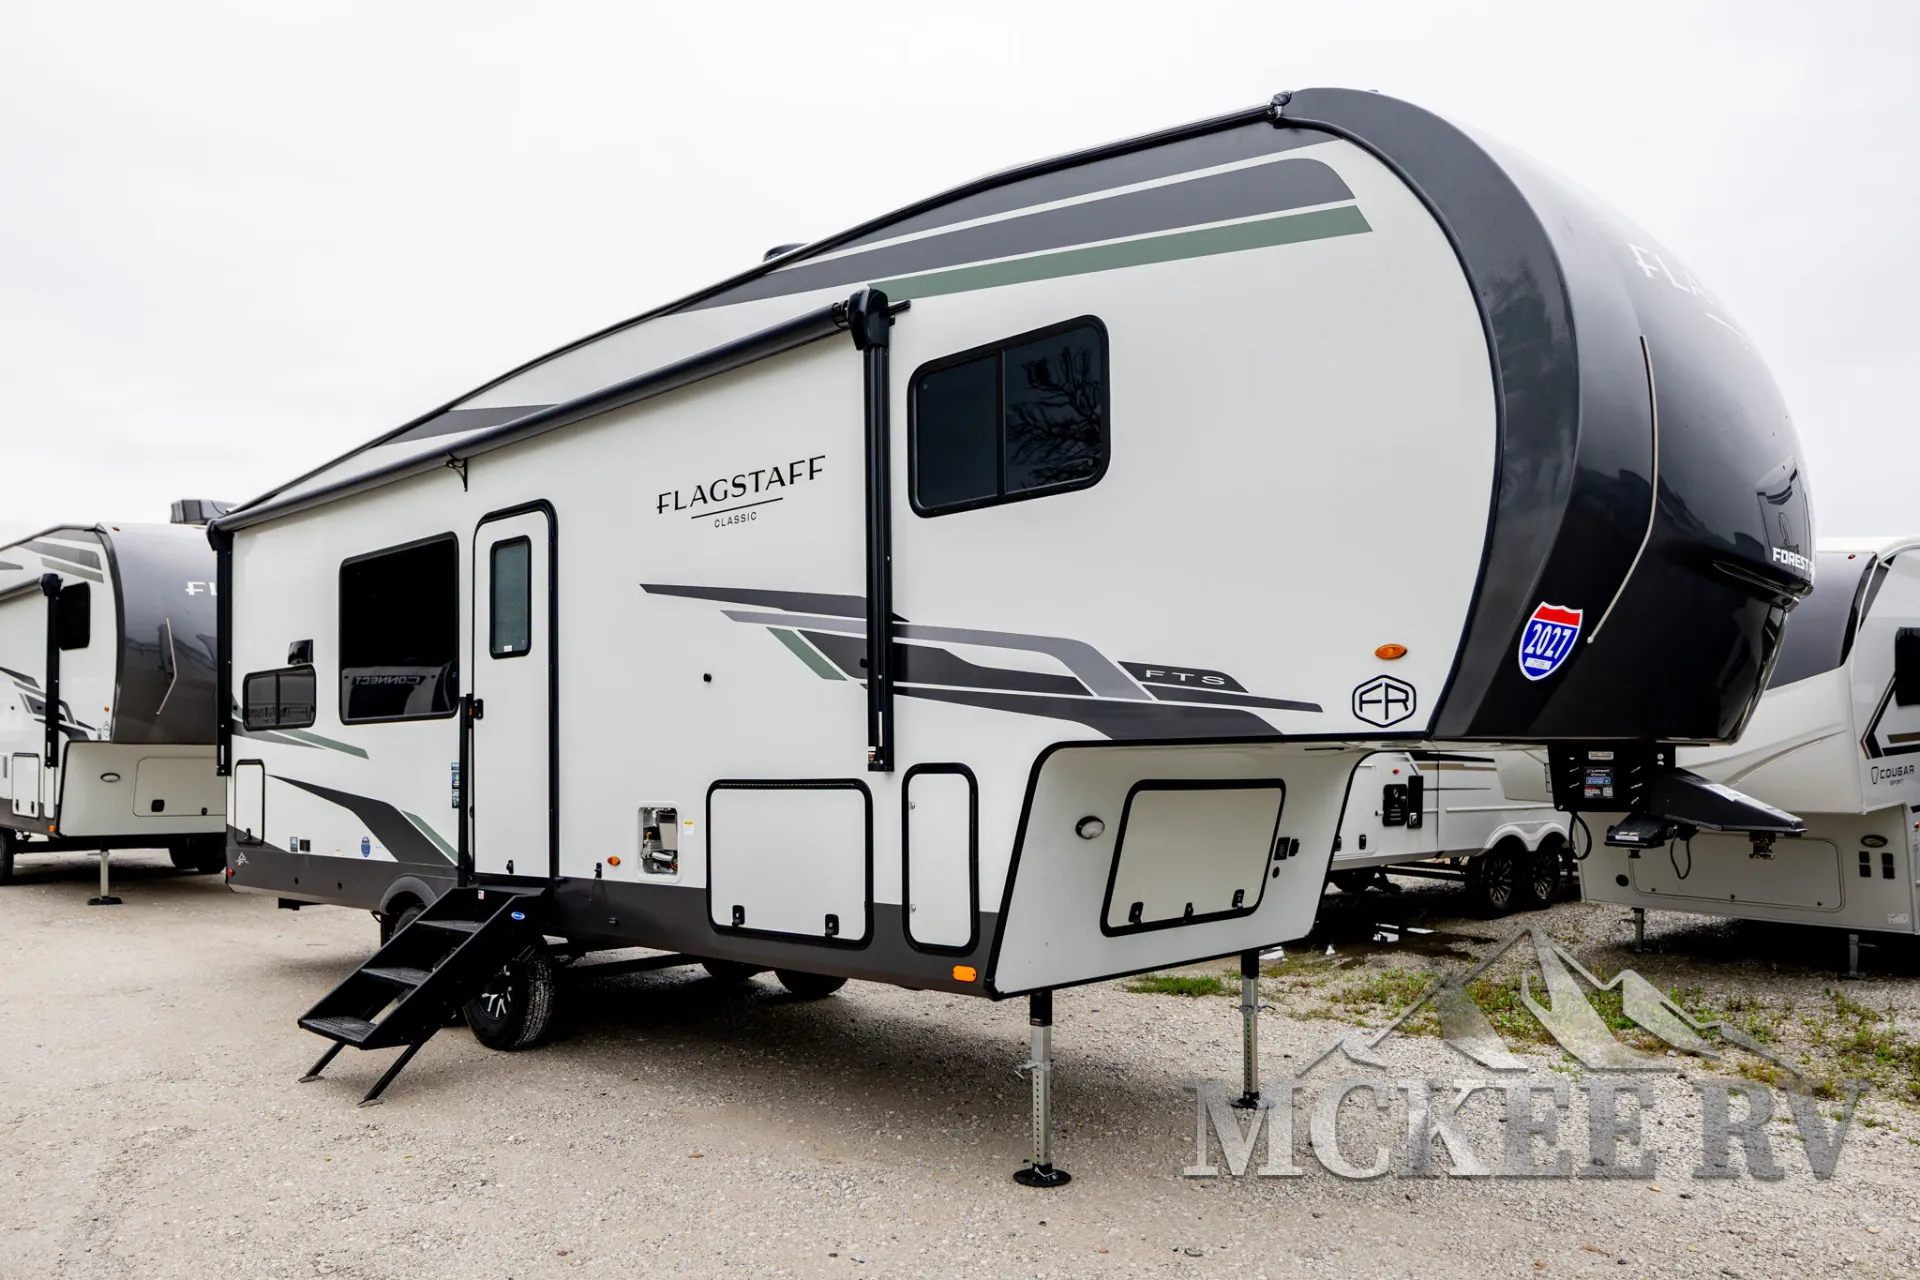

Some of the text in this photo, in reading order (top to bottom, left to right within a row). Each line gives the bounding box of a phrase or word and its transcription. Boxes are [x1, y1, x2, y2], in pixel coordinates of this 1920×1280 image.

[656, 454, 827, 515] FLAGSTAFF
[713, 511, 758, 528] CLASSIC
[1772, 546, 1809, 572] FOREST
[1523, 623, 1573, 660] 2027
[1145, 668, 1226, 686] FTS
[1358, 680, 1410, 721] FR
[1880, 764, 1915, 779] COUGAR
